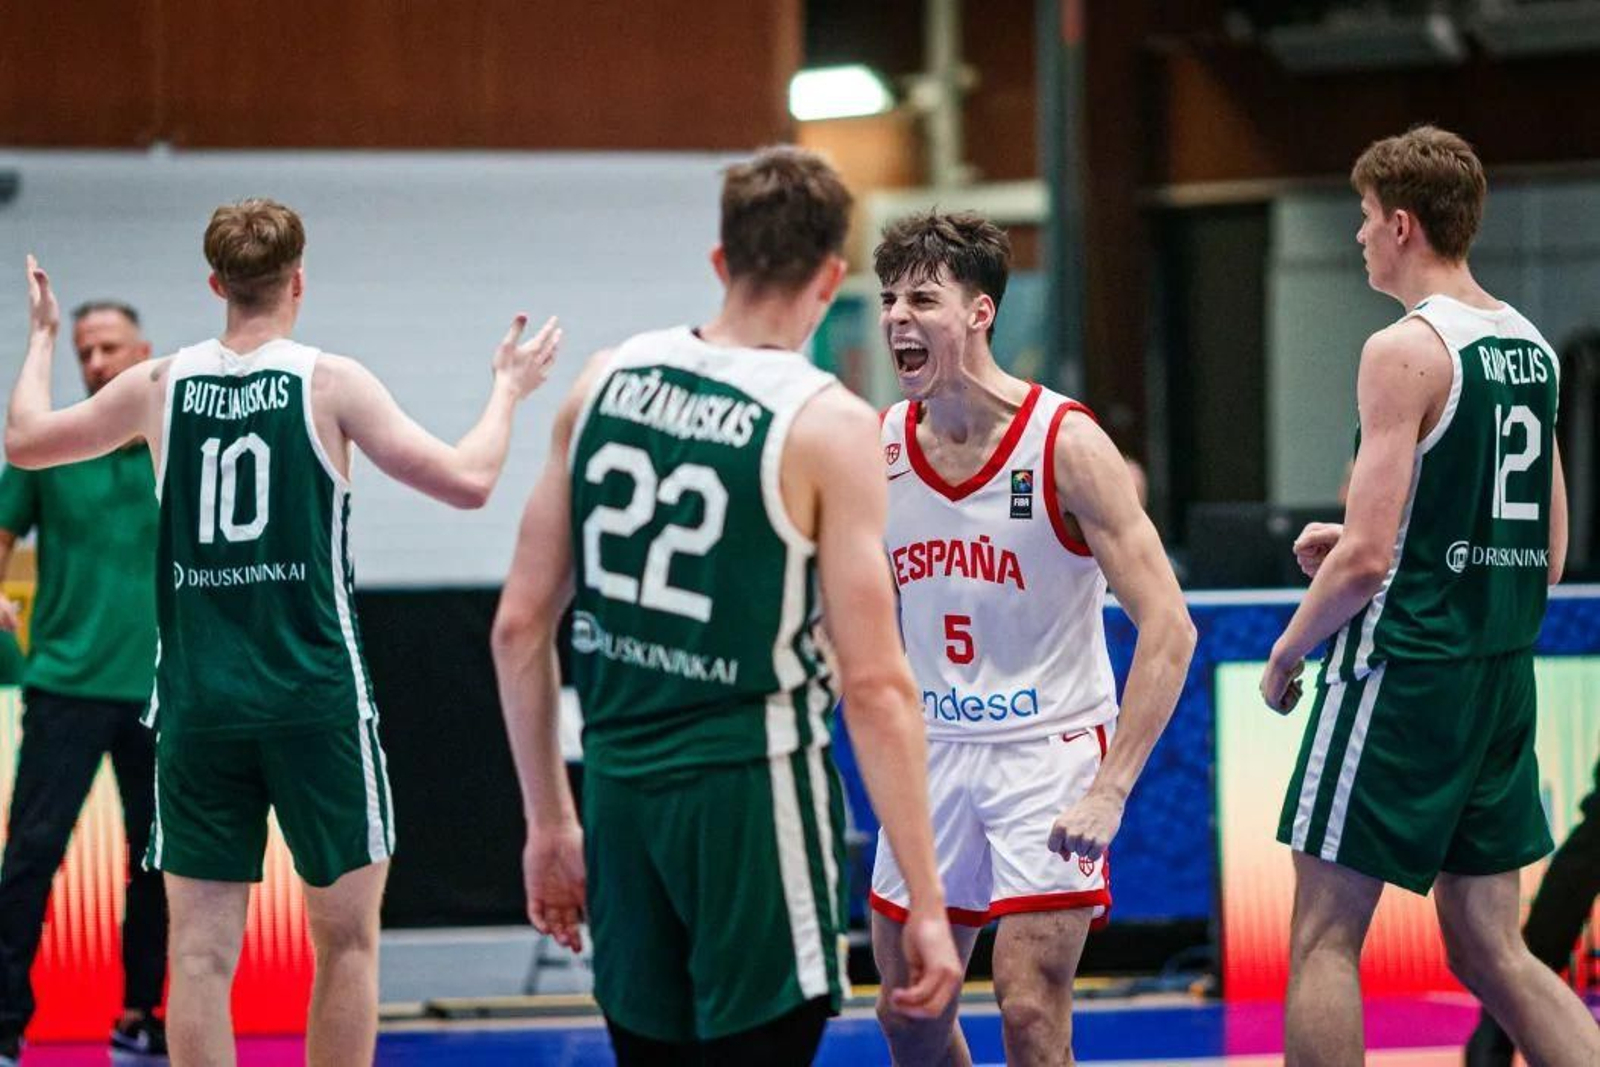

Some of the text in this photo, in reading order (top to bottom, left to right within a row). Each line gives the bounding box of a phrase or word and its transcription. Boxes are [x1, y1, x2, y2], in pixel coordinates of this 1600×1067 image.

[198, 432, 270, 544] 10
[1491, 403, 1541, 520] 12
[583, 441, 728, 623] 22
[892, 534, 1026, 591] ESPAÑA
[944, 614, 974, 665] 5
[922, 687, 1039, 722] ndesa
